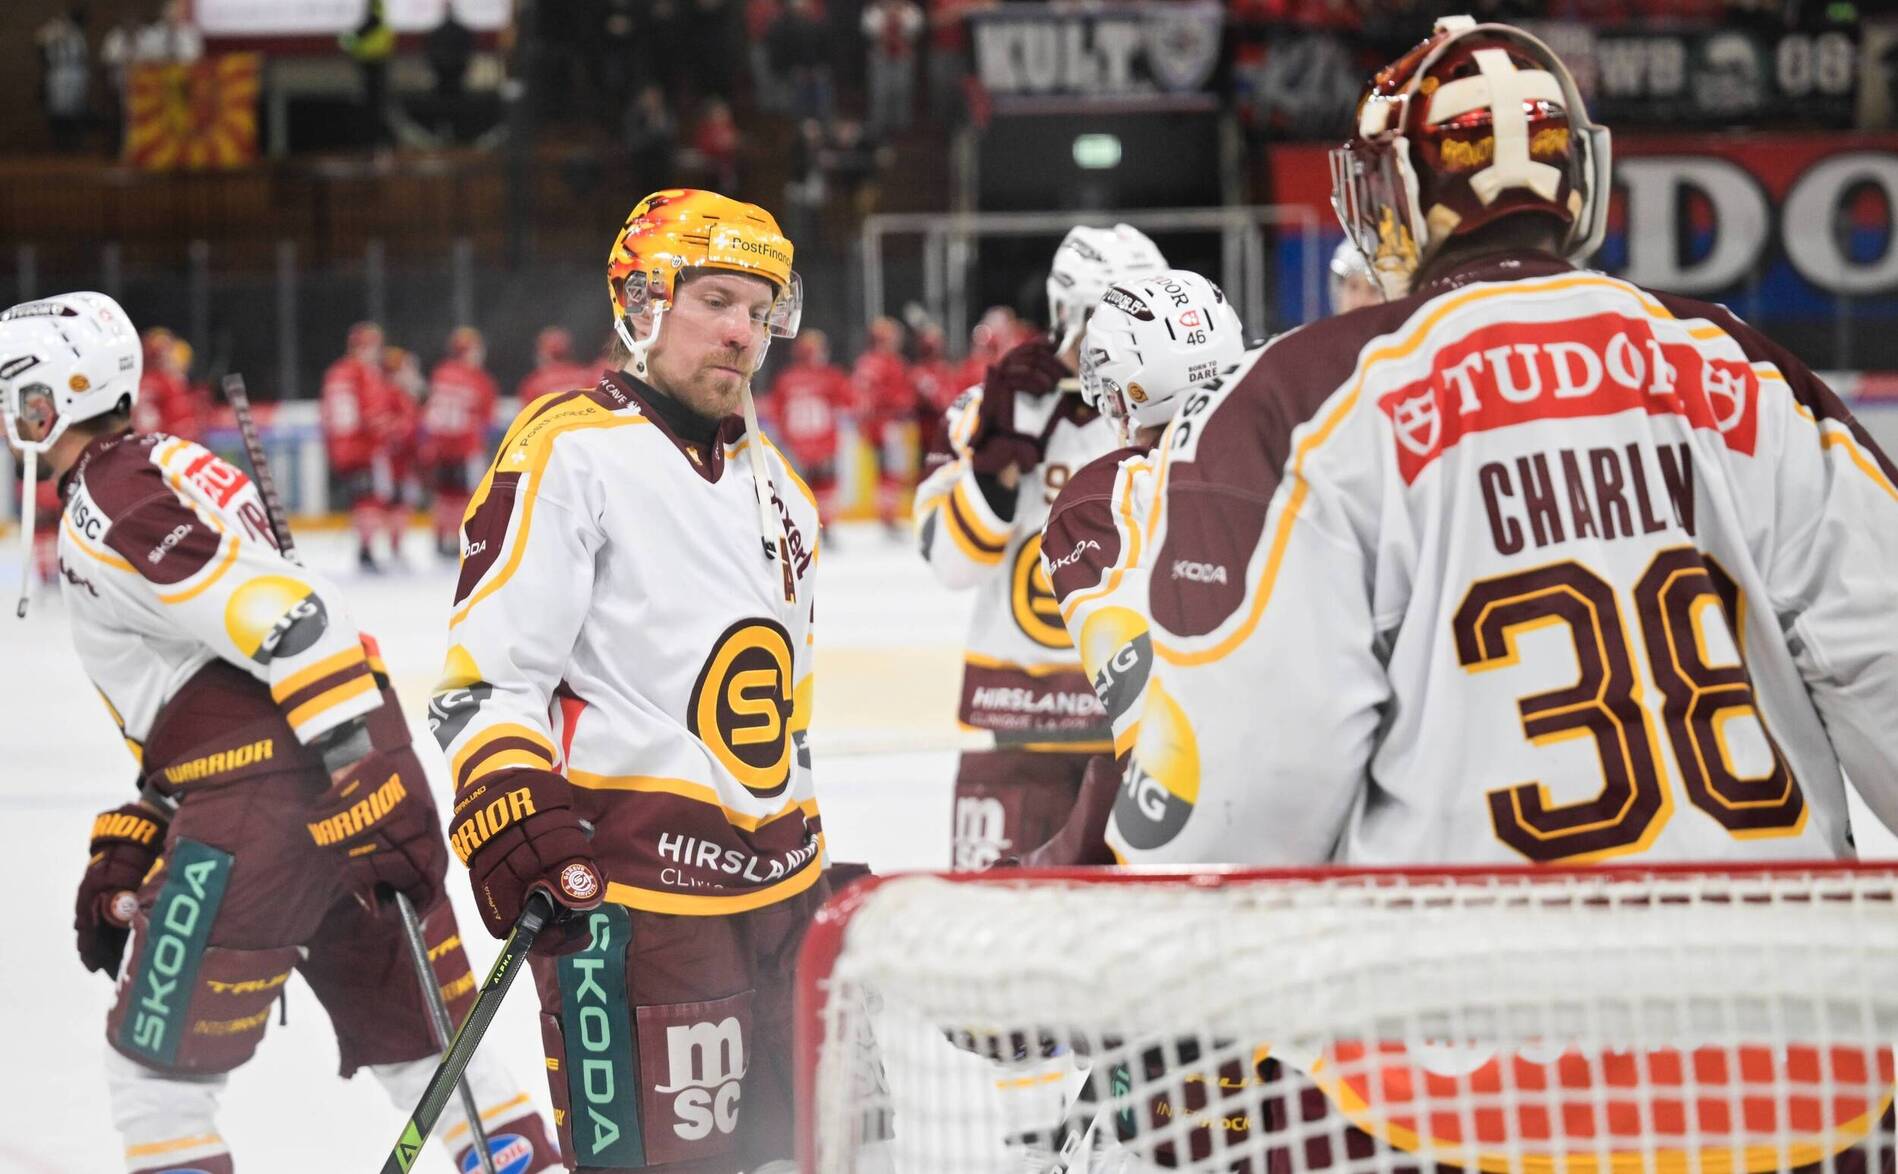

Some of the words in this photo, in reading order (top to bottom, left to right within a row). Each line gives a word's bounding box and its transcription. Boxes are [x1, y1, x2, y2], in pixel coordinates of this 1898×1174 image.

[1186, 329, 1206, 346] 46
[1189, 367, 1217, 382] DARE
[605, 383, 628, 405] CAVE
[1452, 544, 1808, 864] 38
[164, 739, 273, 783] WARRIOR
[1123, 764, 1169, 822] IG
[493, 952, 513, 984] ALPHA
